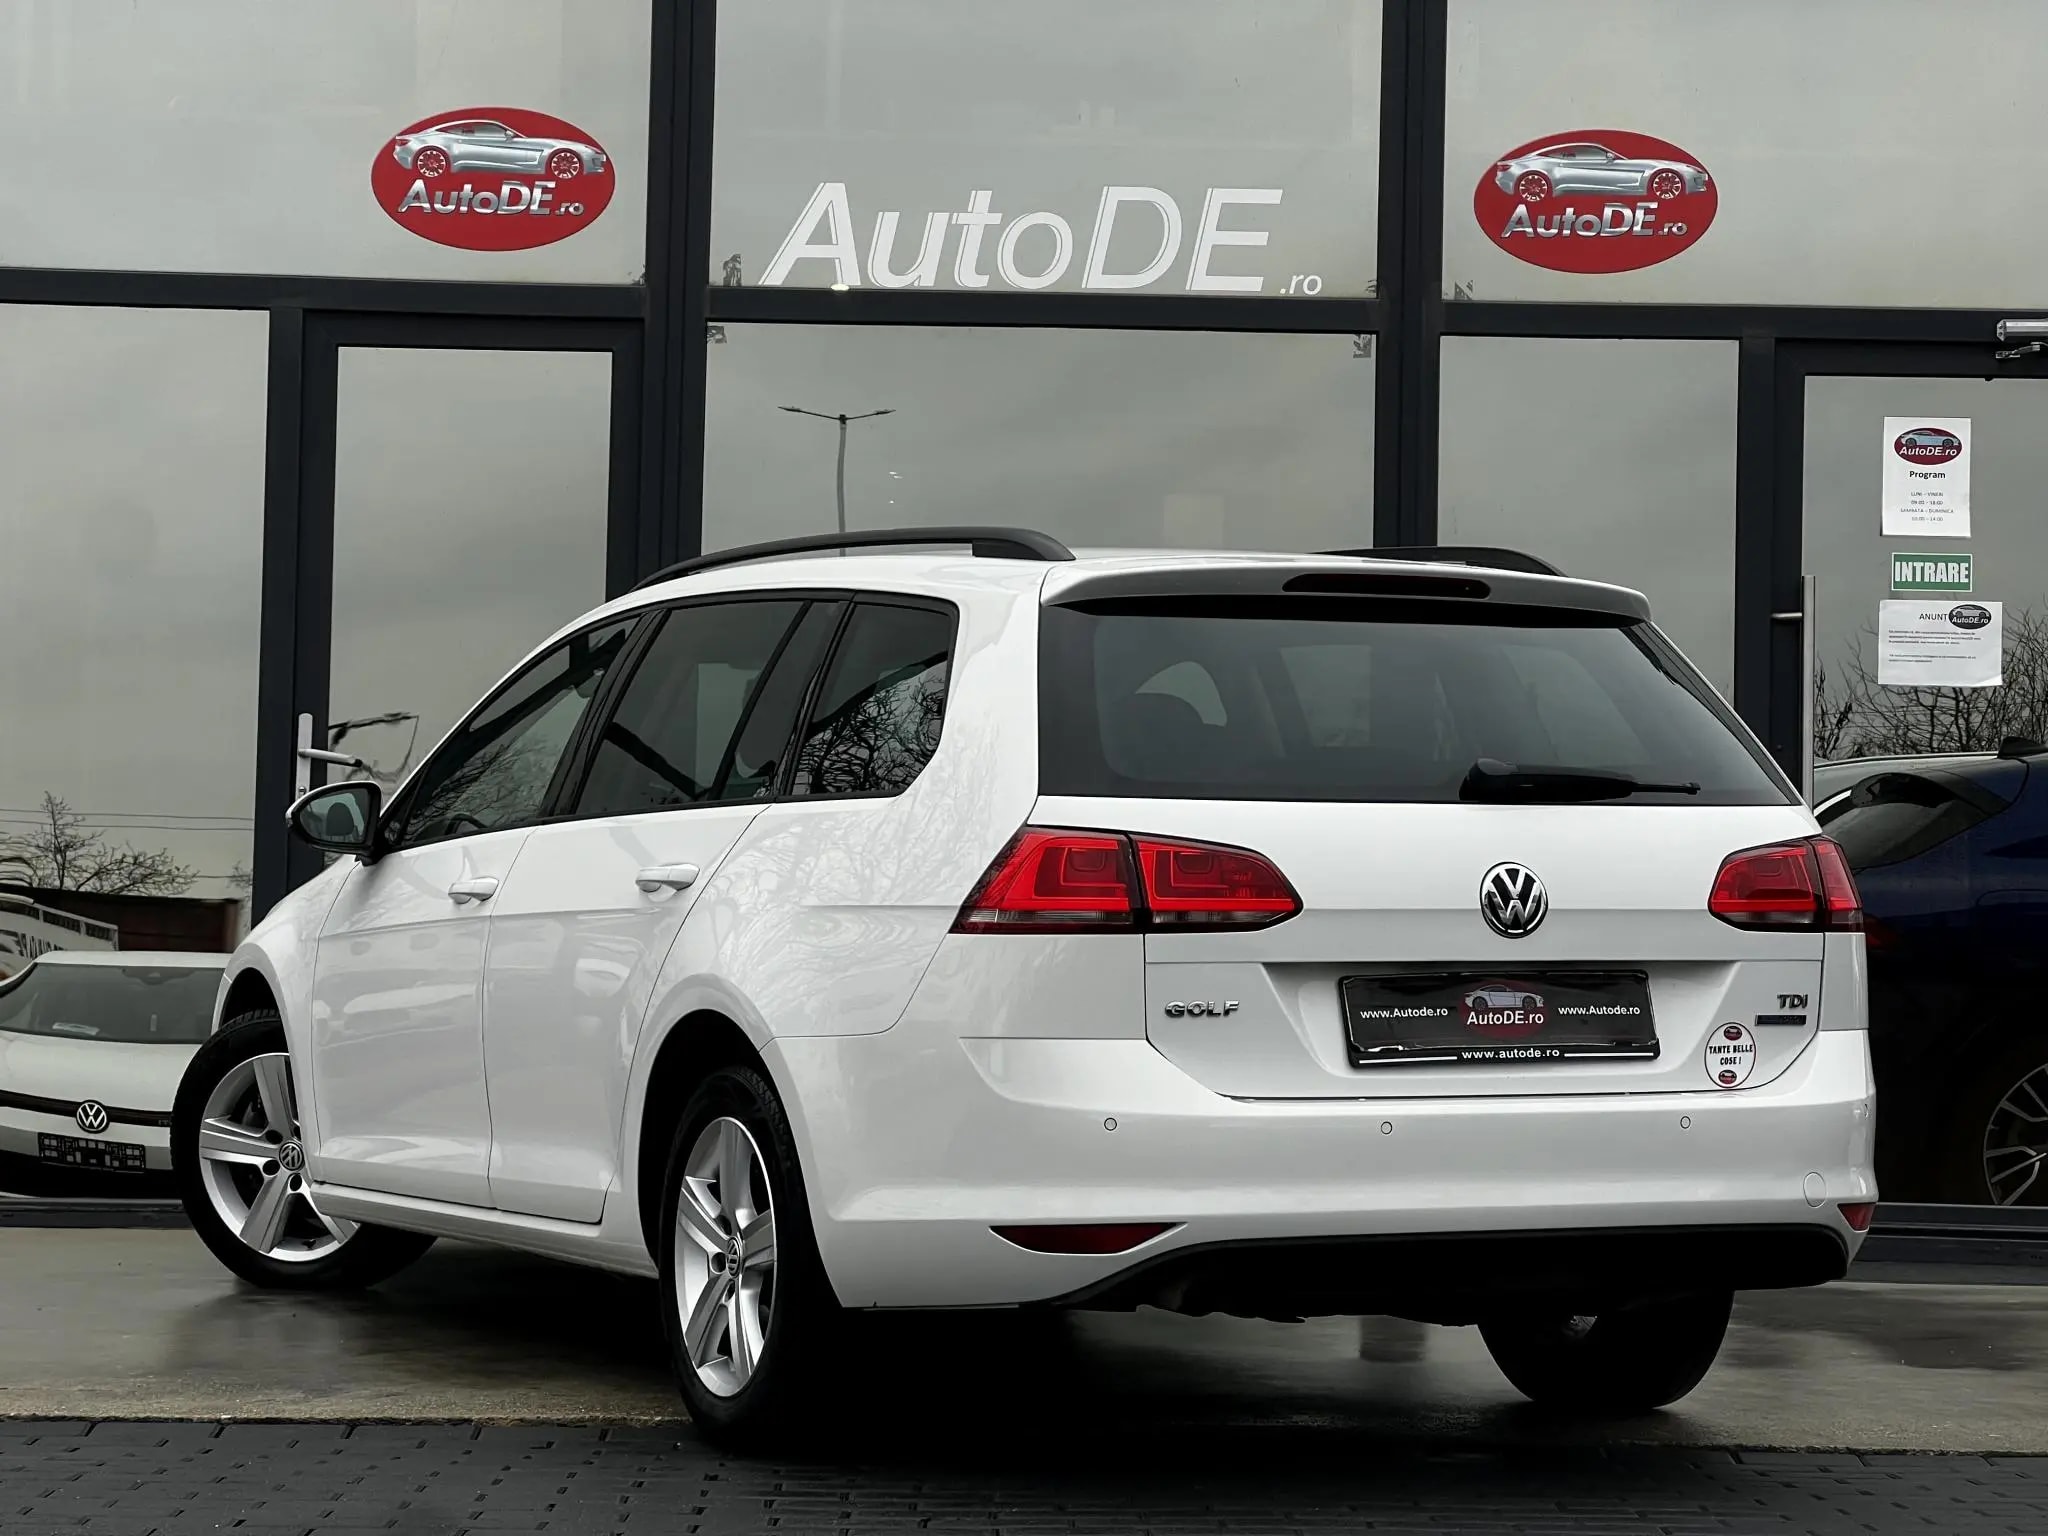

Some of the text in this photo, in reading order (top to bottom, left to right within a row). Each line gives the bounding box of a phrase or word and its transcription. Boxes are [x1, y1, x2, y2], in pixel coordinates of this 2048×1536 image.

[1899, 446, 1957, 456] AutoDE.ro
[1909, 470, 1946, 480] Program
[1894, 561, 1969, 583] INTRARE
[1165, 1001, 1239, 1018] GOLF
[1360, 1006, 1449, 1019] www.Autode.ro
[1558, 1005, 1641, 1016] www.Autode.ro
[1466, 1010, 1544, 1026] AutoDE.ro
[1461, 1047, 1560, 1060] www.autode.ro
[1709, 1044, 1753, 1054] TANTE BELLE
